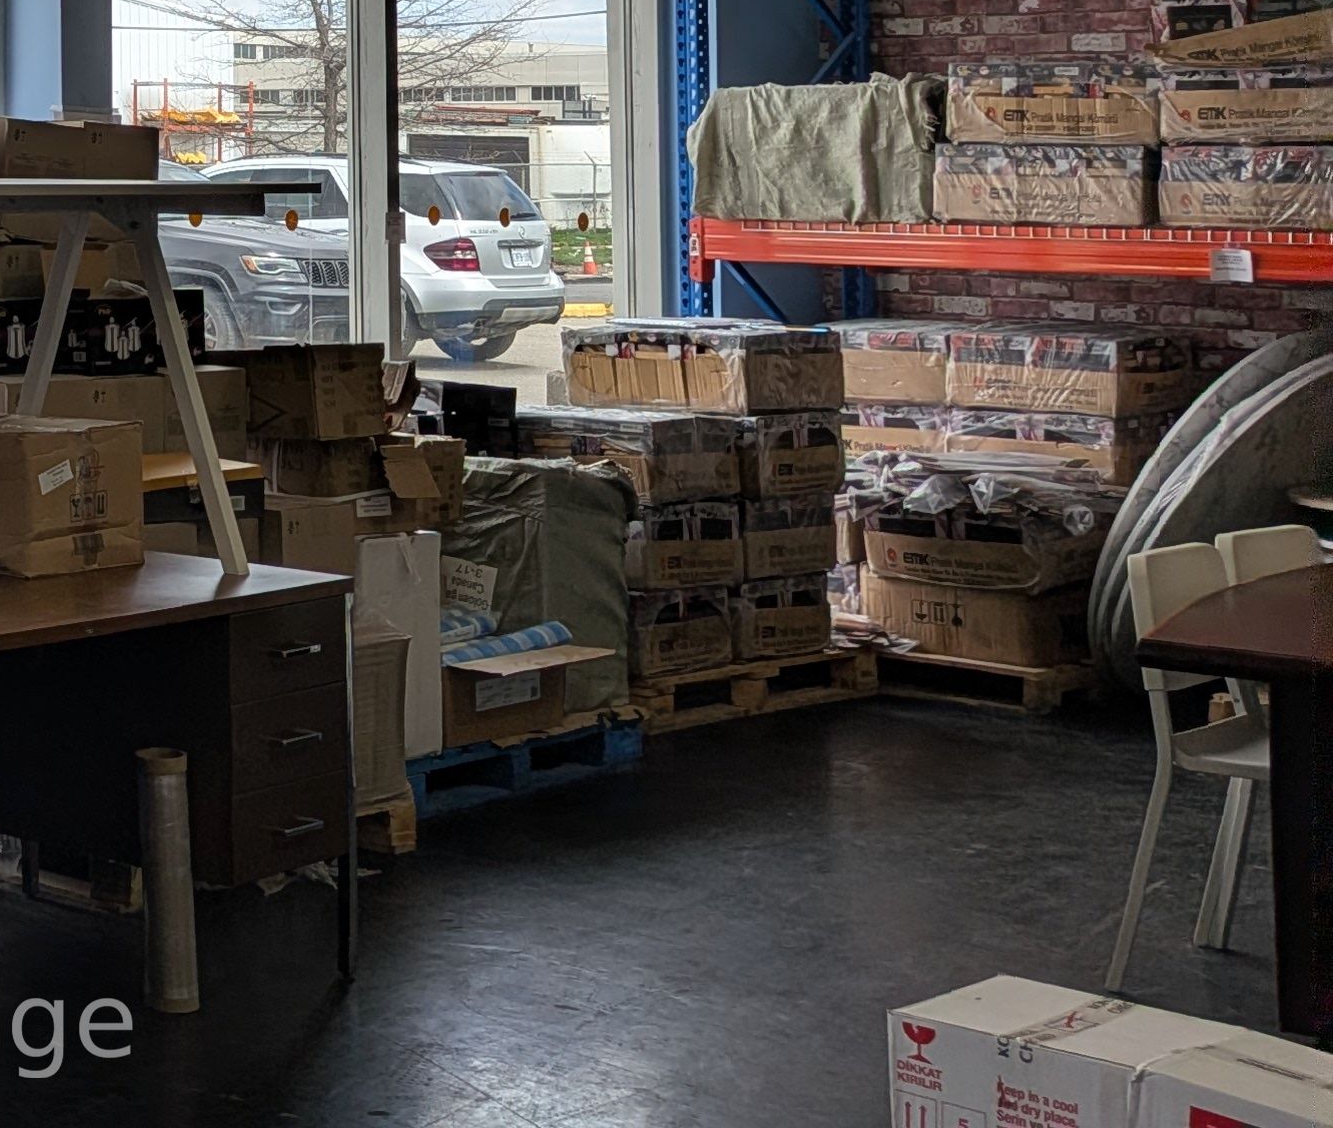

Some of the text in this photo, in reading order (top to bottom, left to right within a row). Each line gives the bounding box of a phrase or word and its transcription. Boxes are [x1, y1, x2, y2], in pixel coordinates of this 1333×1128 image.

[1004, 109, 1030, 122] EMK
[1197, 107, 1227, 120] EMK
[903, 551, 930, 565] EMK
[1028, 1089, 1041, 1103] in
[1042, 1095, 1051, 1108] a
[1052, 1099, 1079, 1115] cool
[997, 1109, 1027, 1128] Serin
[1021, 1102, 1041, 1120] dry
